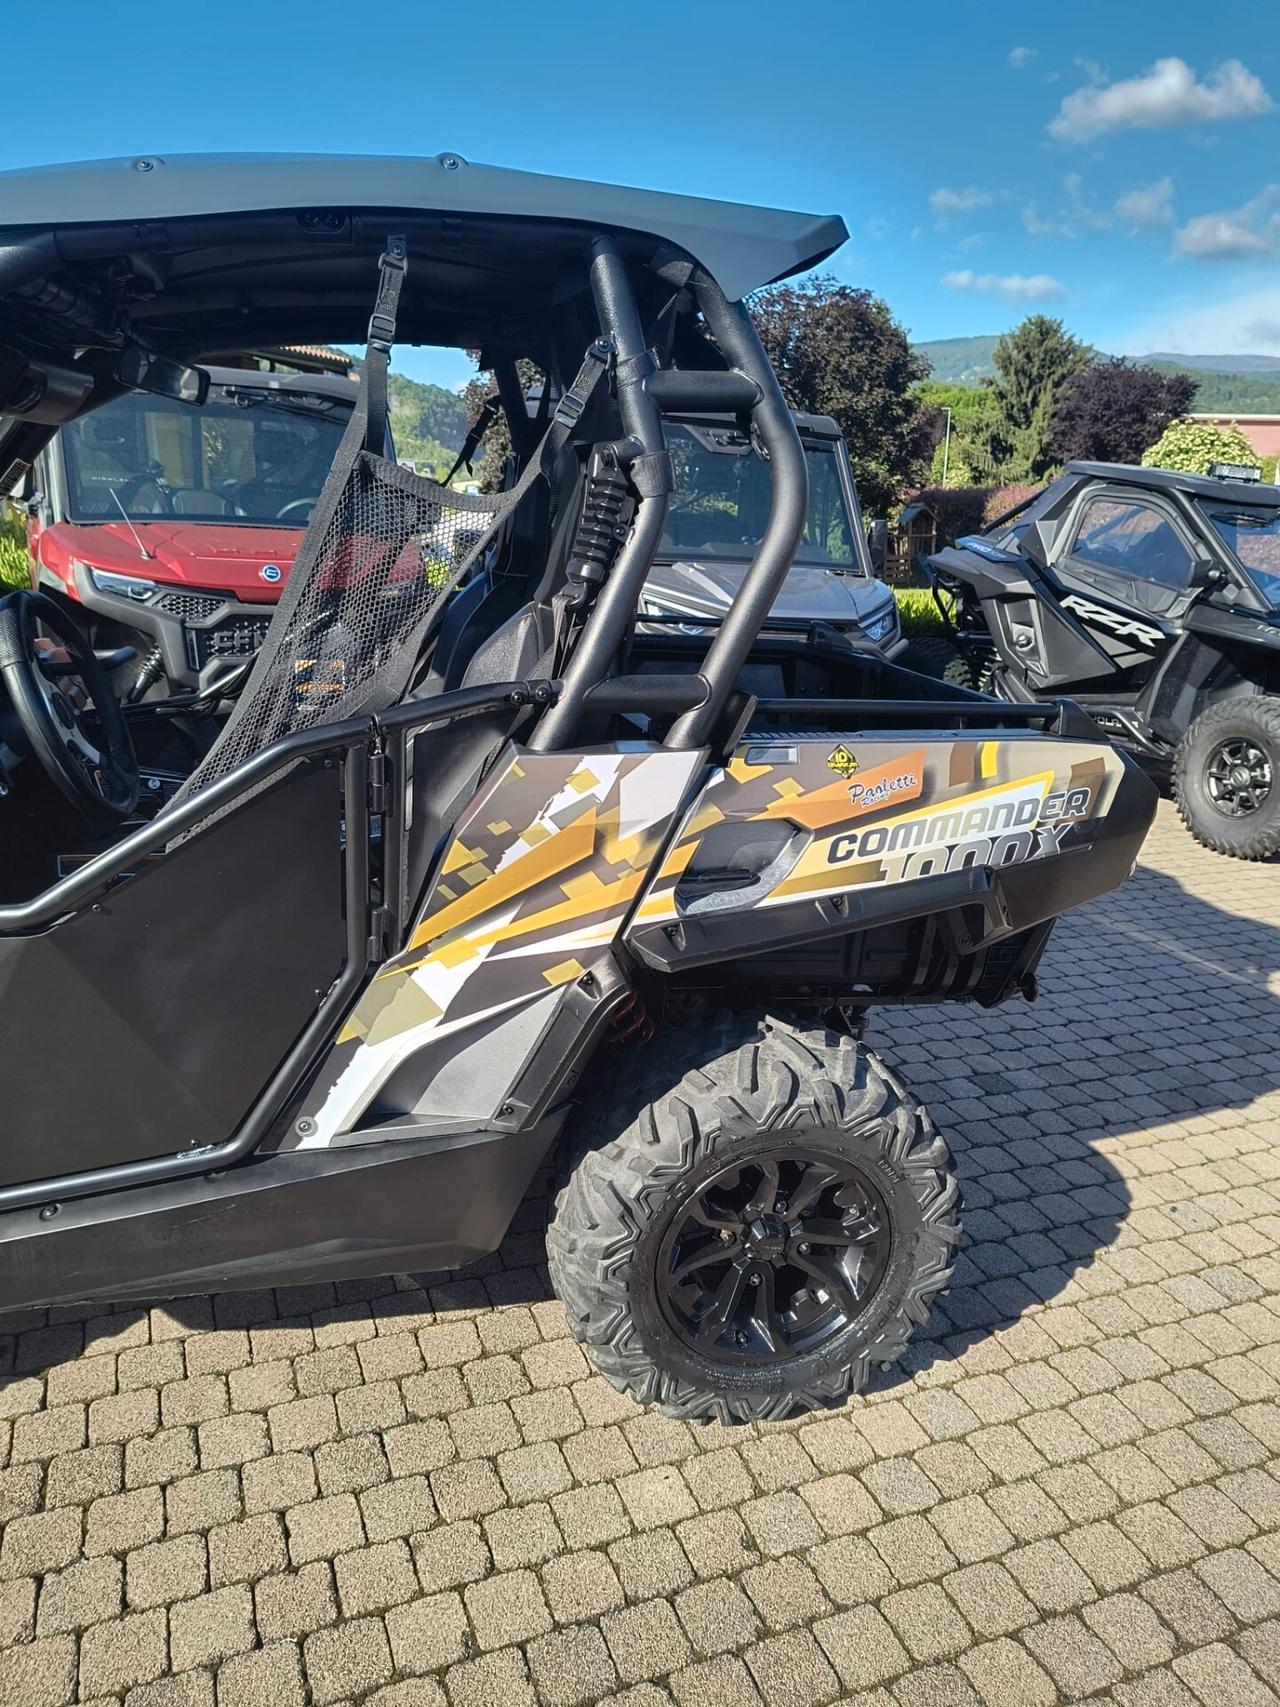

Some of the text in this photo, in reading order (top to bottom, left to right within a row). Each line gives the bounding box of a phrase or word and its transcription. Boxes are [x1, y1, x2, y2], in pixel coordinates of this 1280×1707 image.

[1059, 594, 1166, 648] RZR
[848, 773, 916, 804] Paoletti
[827, 787, 1090, 864] COMMANDER
[880, 822, 1072, 884] 1000X
